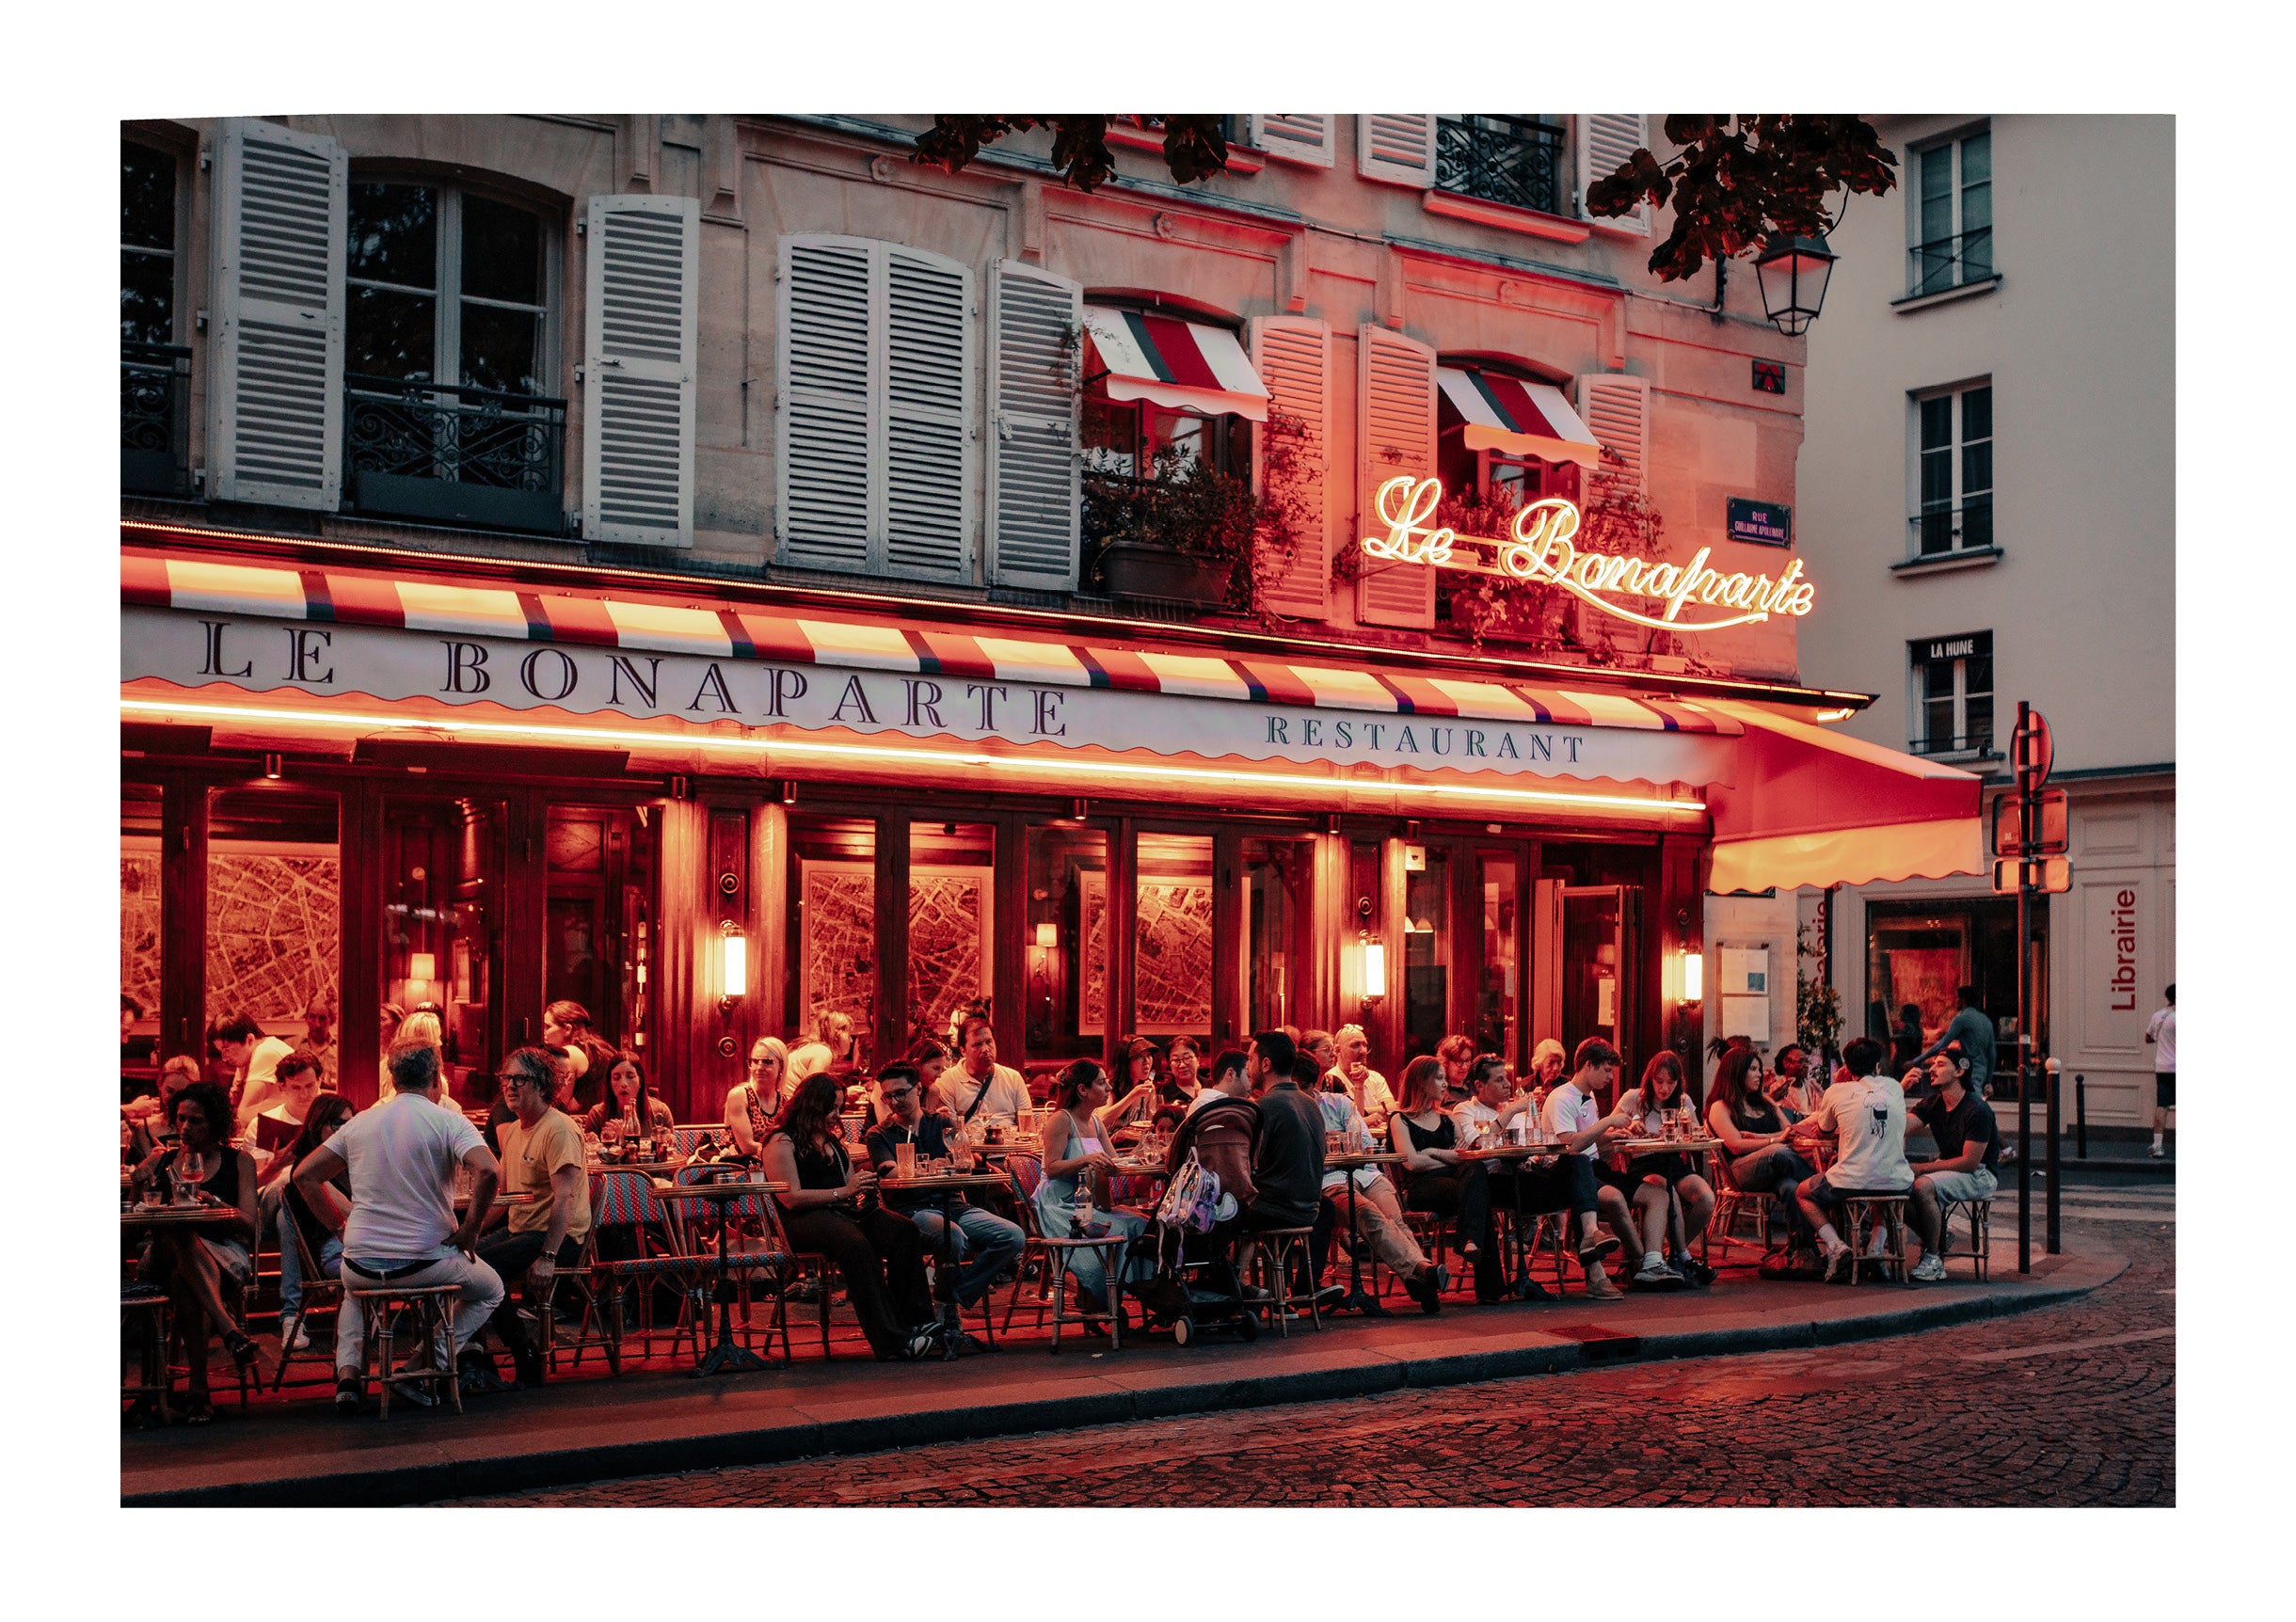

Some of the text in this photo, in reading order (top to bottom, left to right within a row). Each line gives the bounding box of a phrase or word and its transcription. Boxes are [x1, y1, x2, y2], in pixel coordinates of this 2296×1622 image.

[1361, 475, 1816, 631] Le Bonaparte
[1752, 511, 1768, 523] RUE
[196, 620, 1067, 738] LE BONAPARTE
[1931, 639, 1974, 659] LA HUNE
[1264, 715, 1584, 764] RESTAURANT
[2111, 889, 2136, 1011] Librairie
